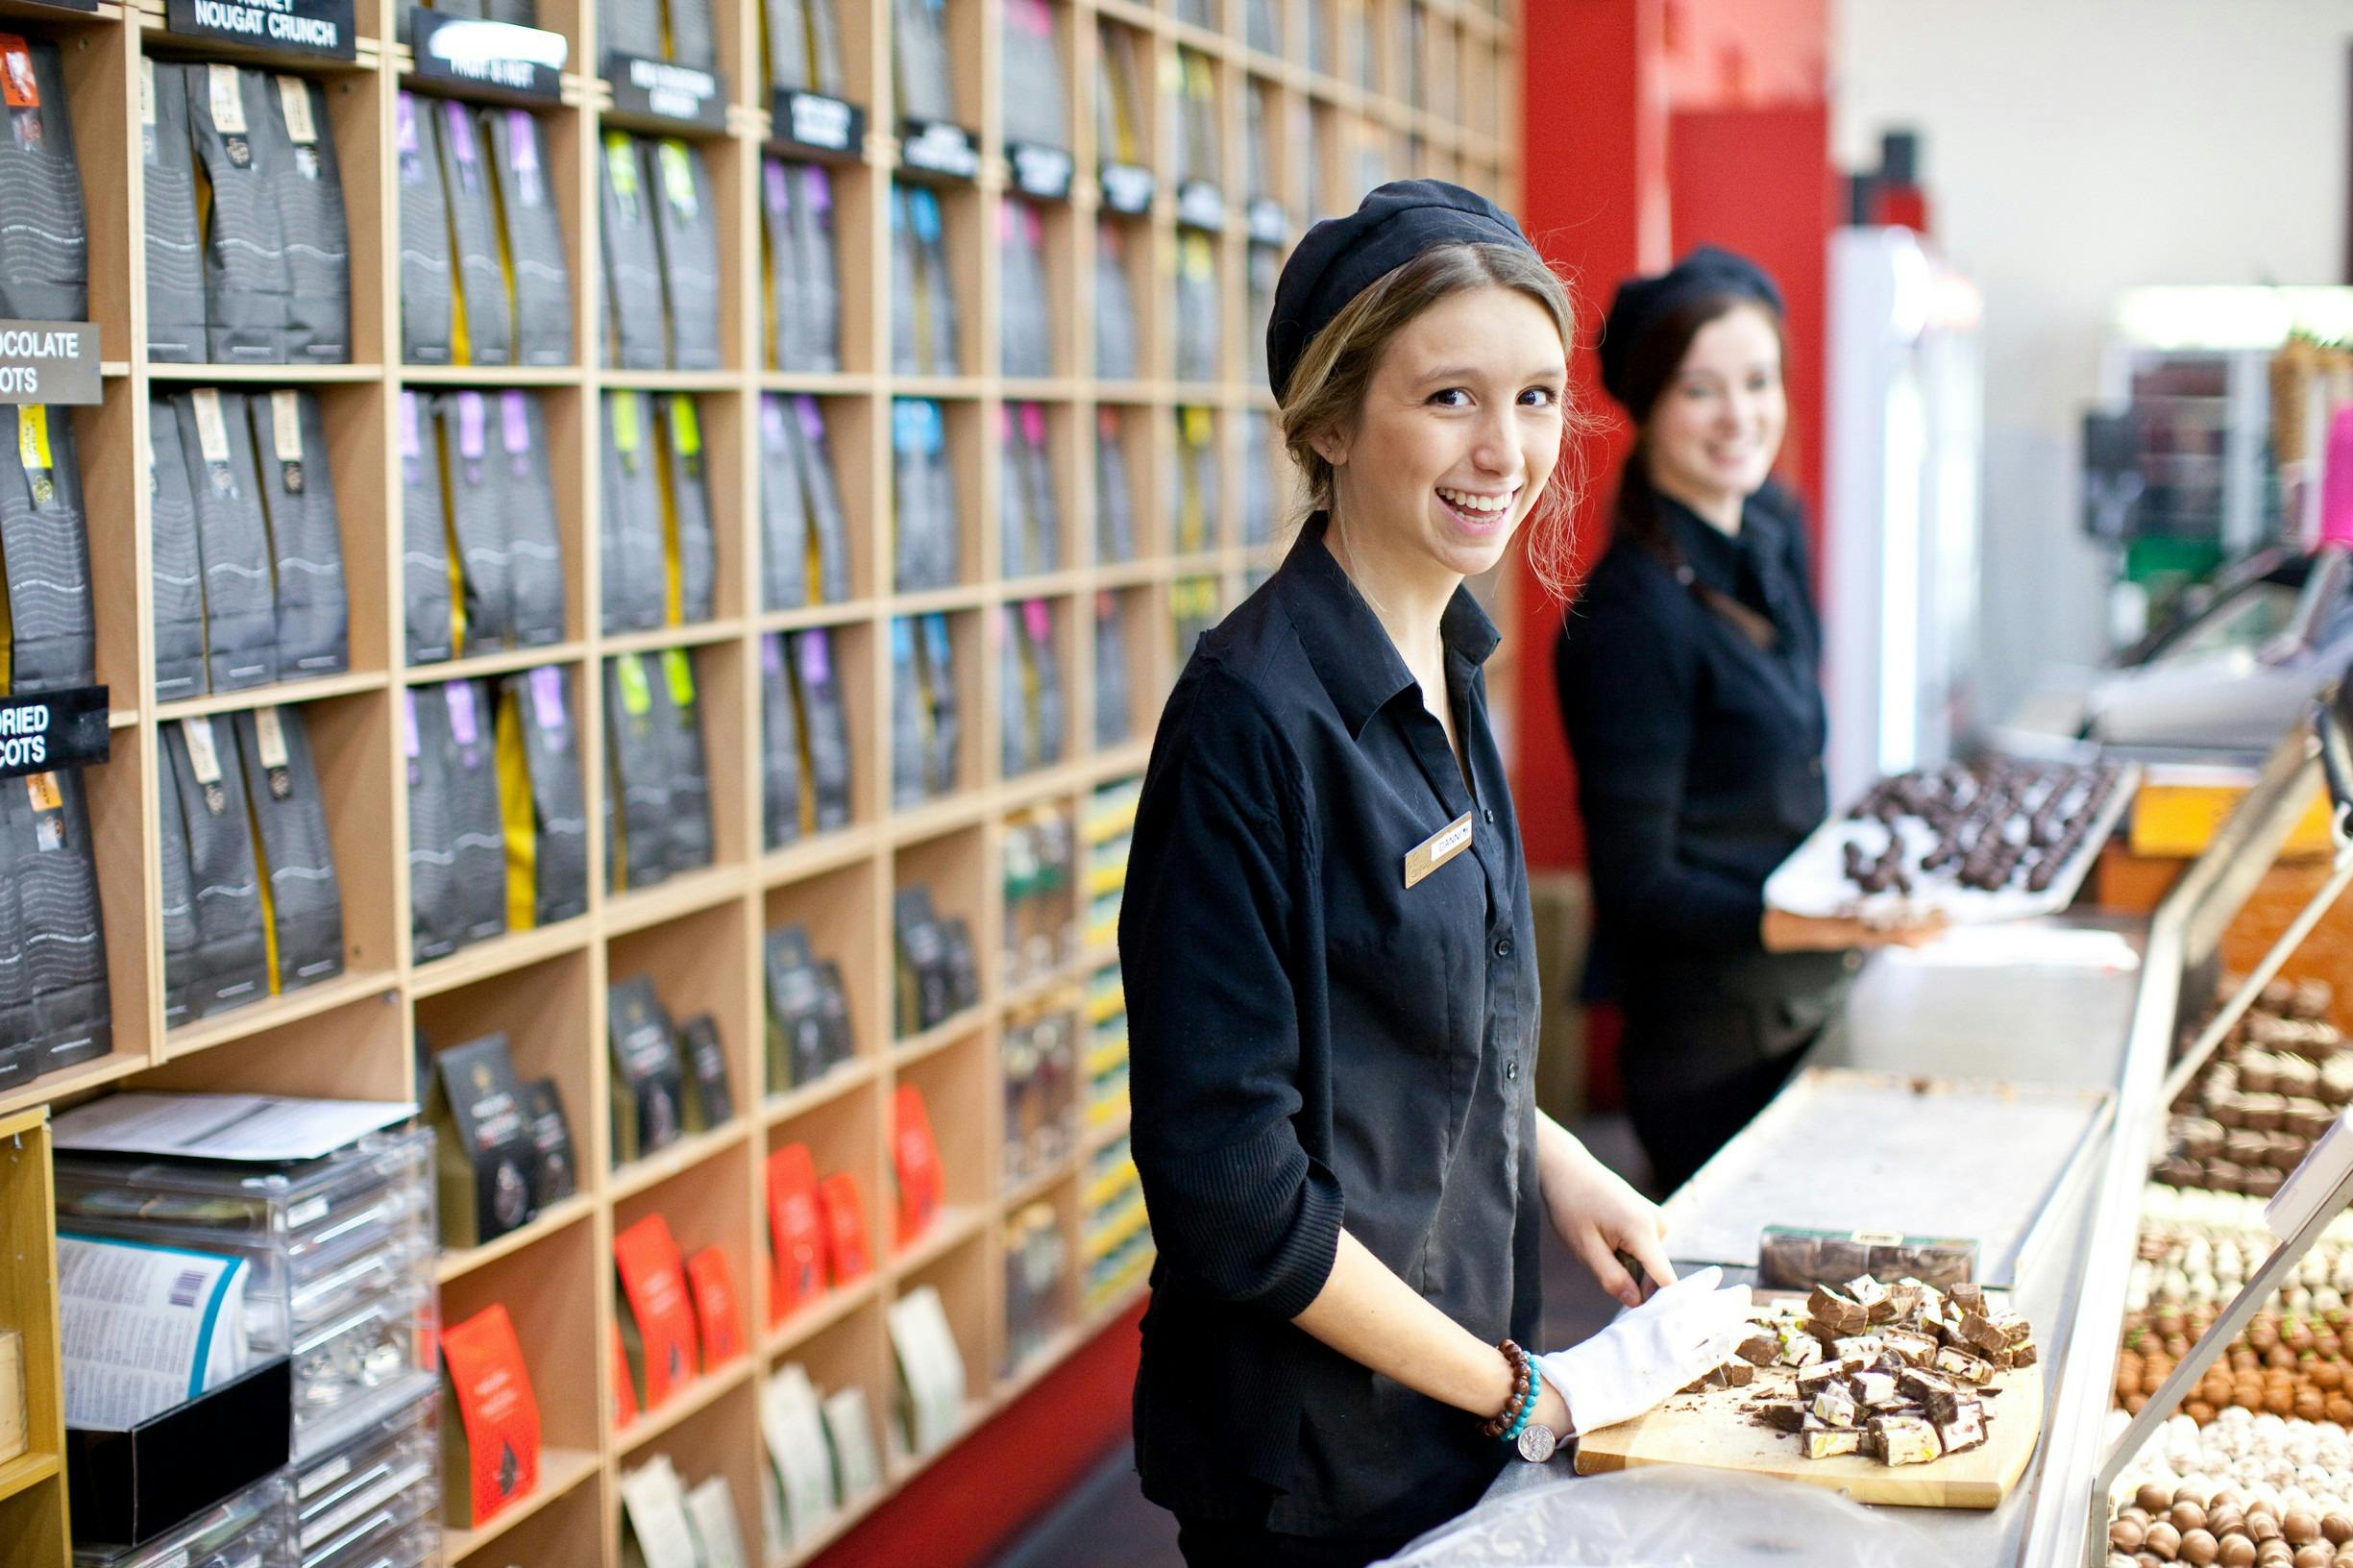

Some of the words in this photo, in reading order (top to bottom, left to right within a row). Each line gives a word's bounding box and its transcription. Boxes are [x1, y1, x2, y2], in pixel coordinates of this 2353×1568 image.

[195, 0, 265, 35] NOUGAT
[267, 12, 338, 47] CRUNCH
[0, 331, 80, 358] COLATE
[0, 704, 49, 737] RIED
